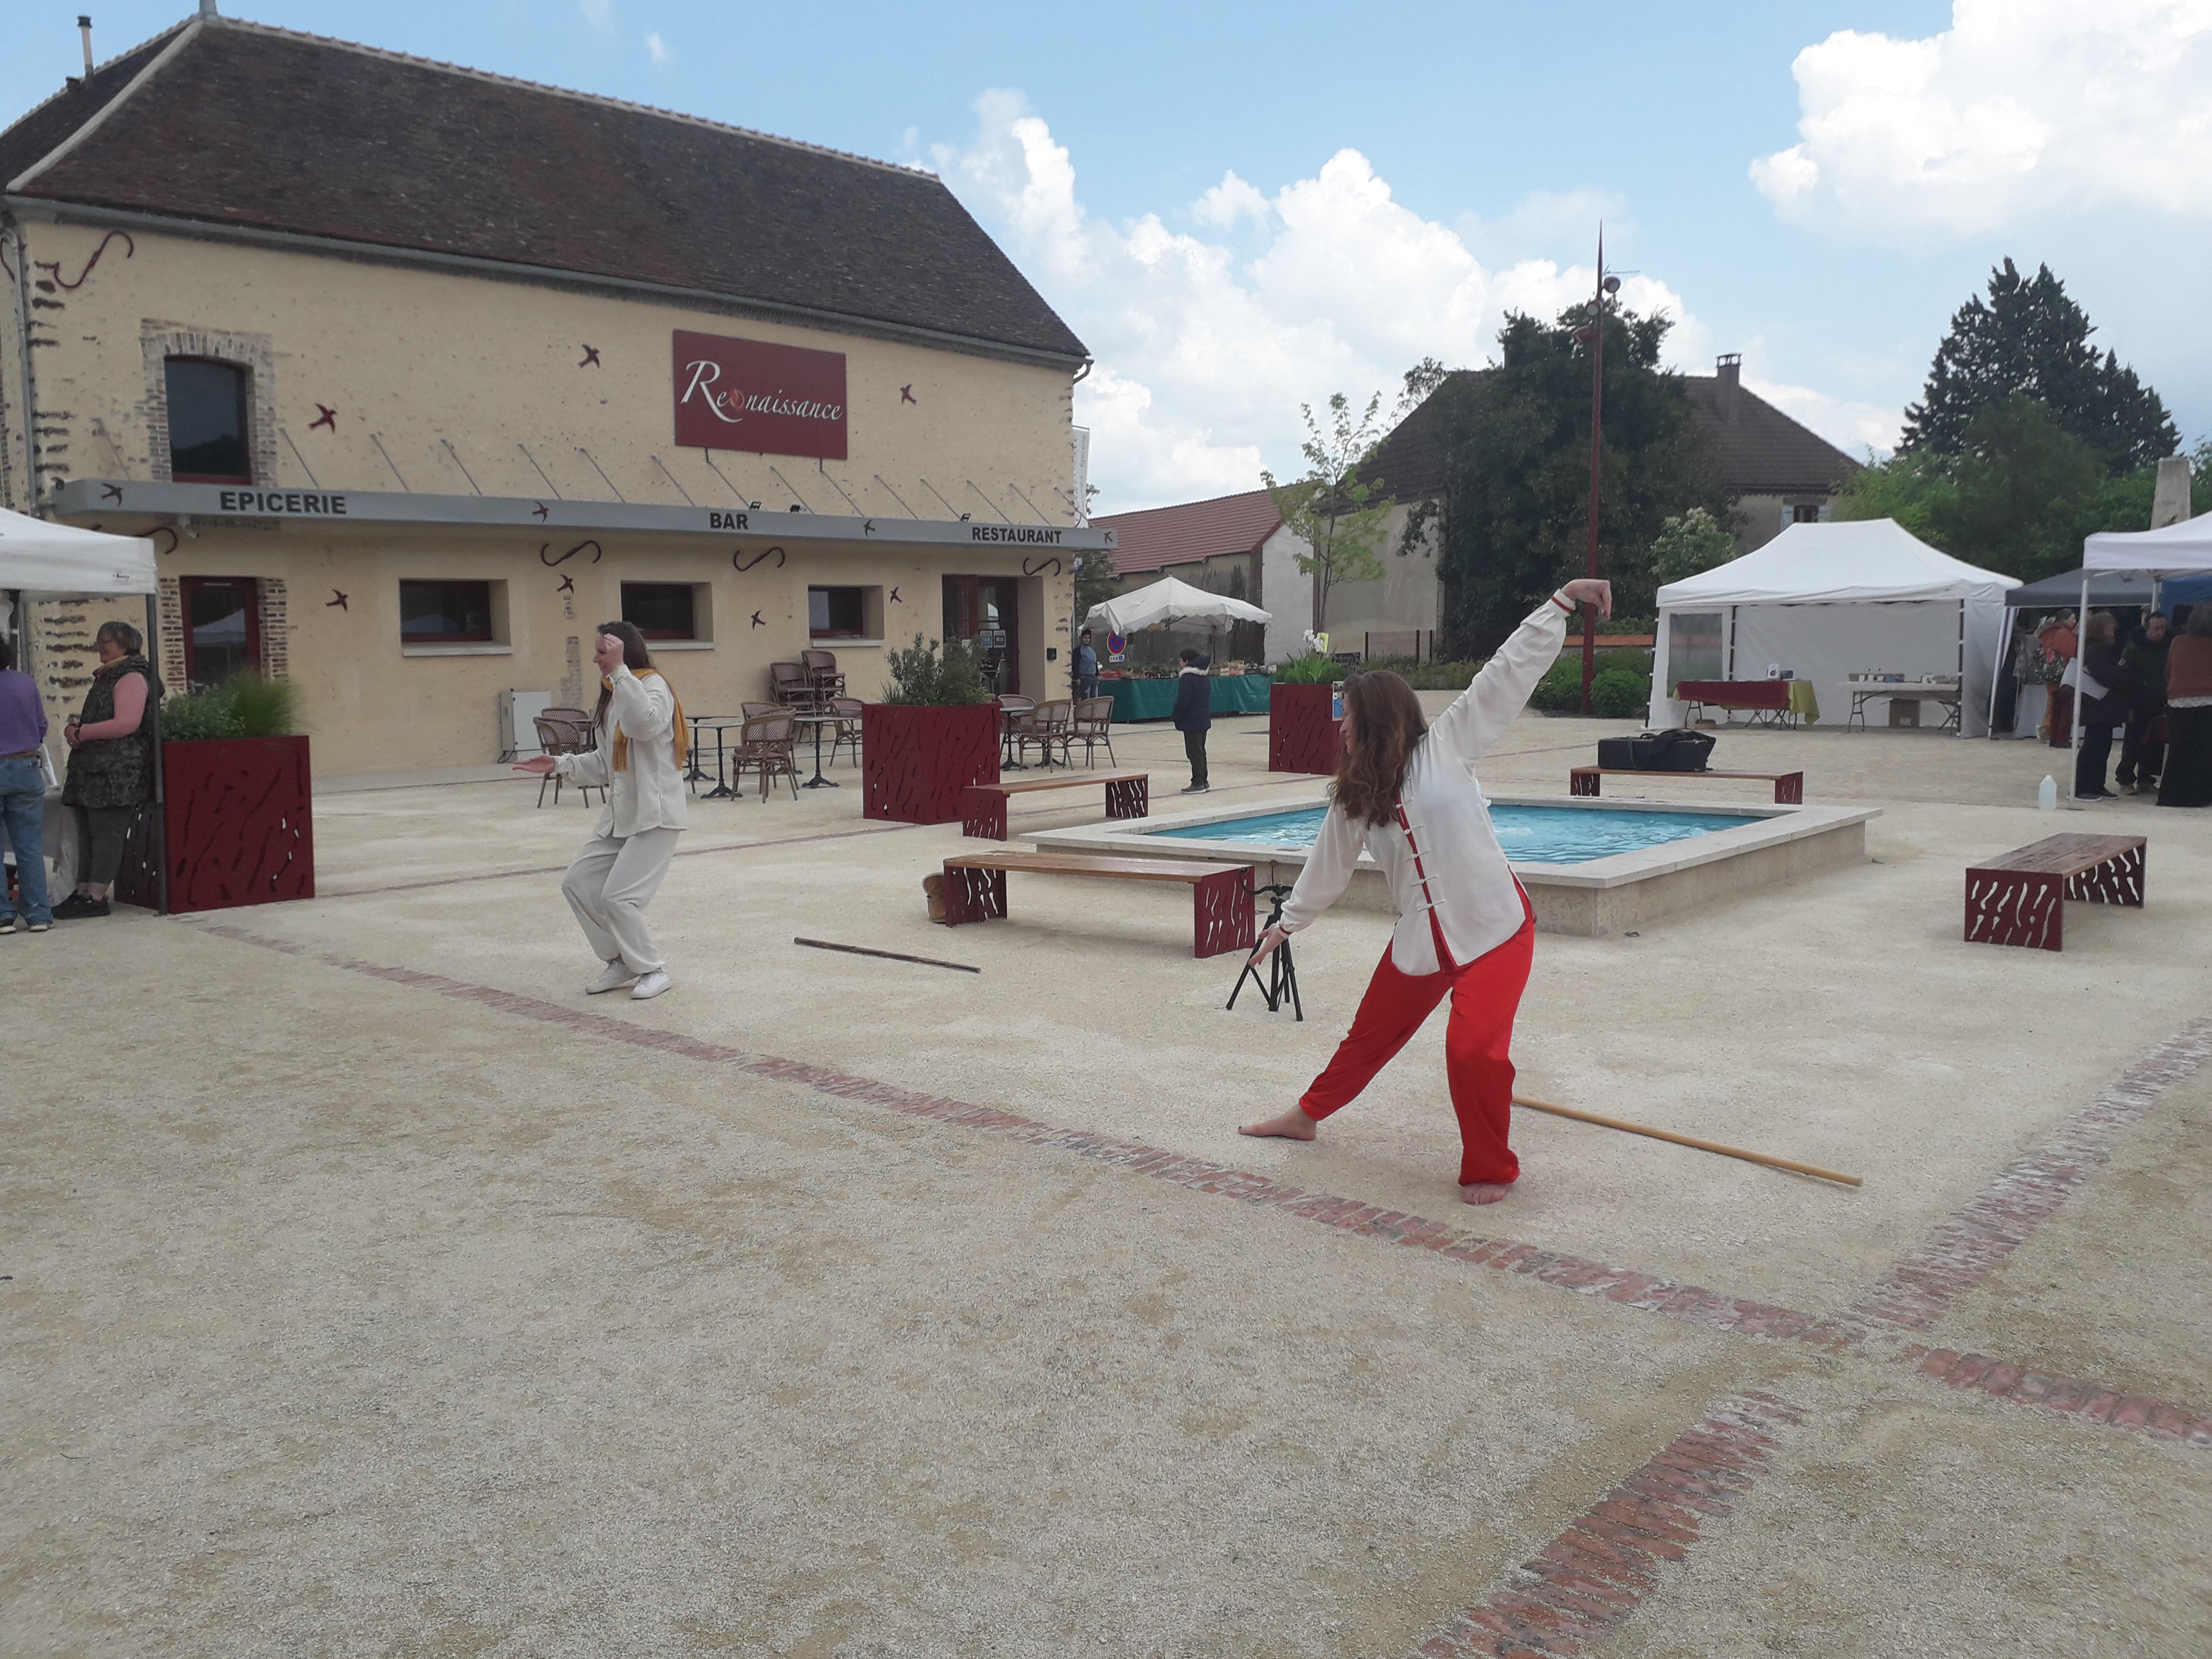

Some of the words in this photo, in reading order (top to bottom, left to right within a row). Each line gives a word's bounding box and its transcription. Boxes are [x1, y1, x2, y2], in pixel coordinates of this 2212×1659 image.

[680, 360, 843, 423] Renaissance
[220, 491, 347, 514] EPICERIE
[709, 512, 749, 530] BAR
[972, 527, 1062, 544] RESTAURANT
